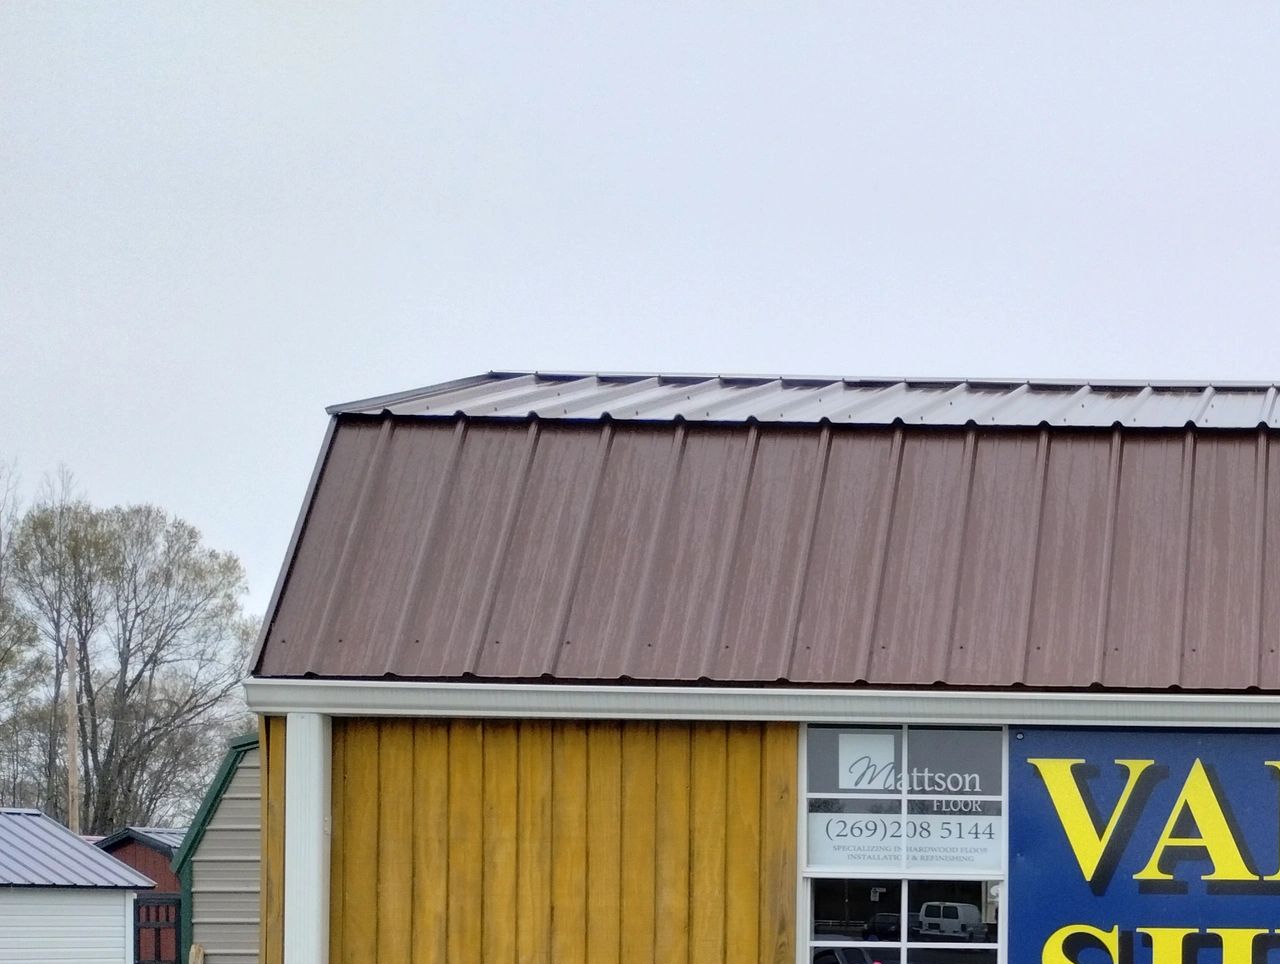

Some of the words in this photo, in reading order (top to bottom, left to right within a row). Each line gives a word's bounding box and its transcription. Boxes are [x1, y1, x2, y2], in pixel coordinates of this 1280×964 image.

[848, 756, 983, 793] Mattson
[933, 800, 983, 812] FLOOR
[825, 818, 932, 842] (269)208
[940, 821, 995, 840] 5144
